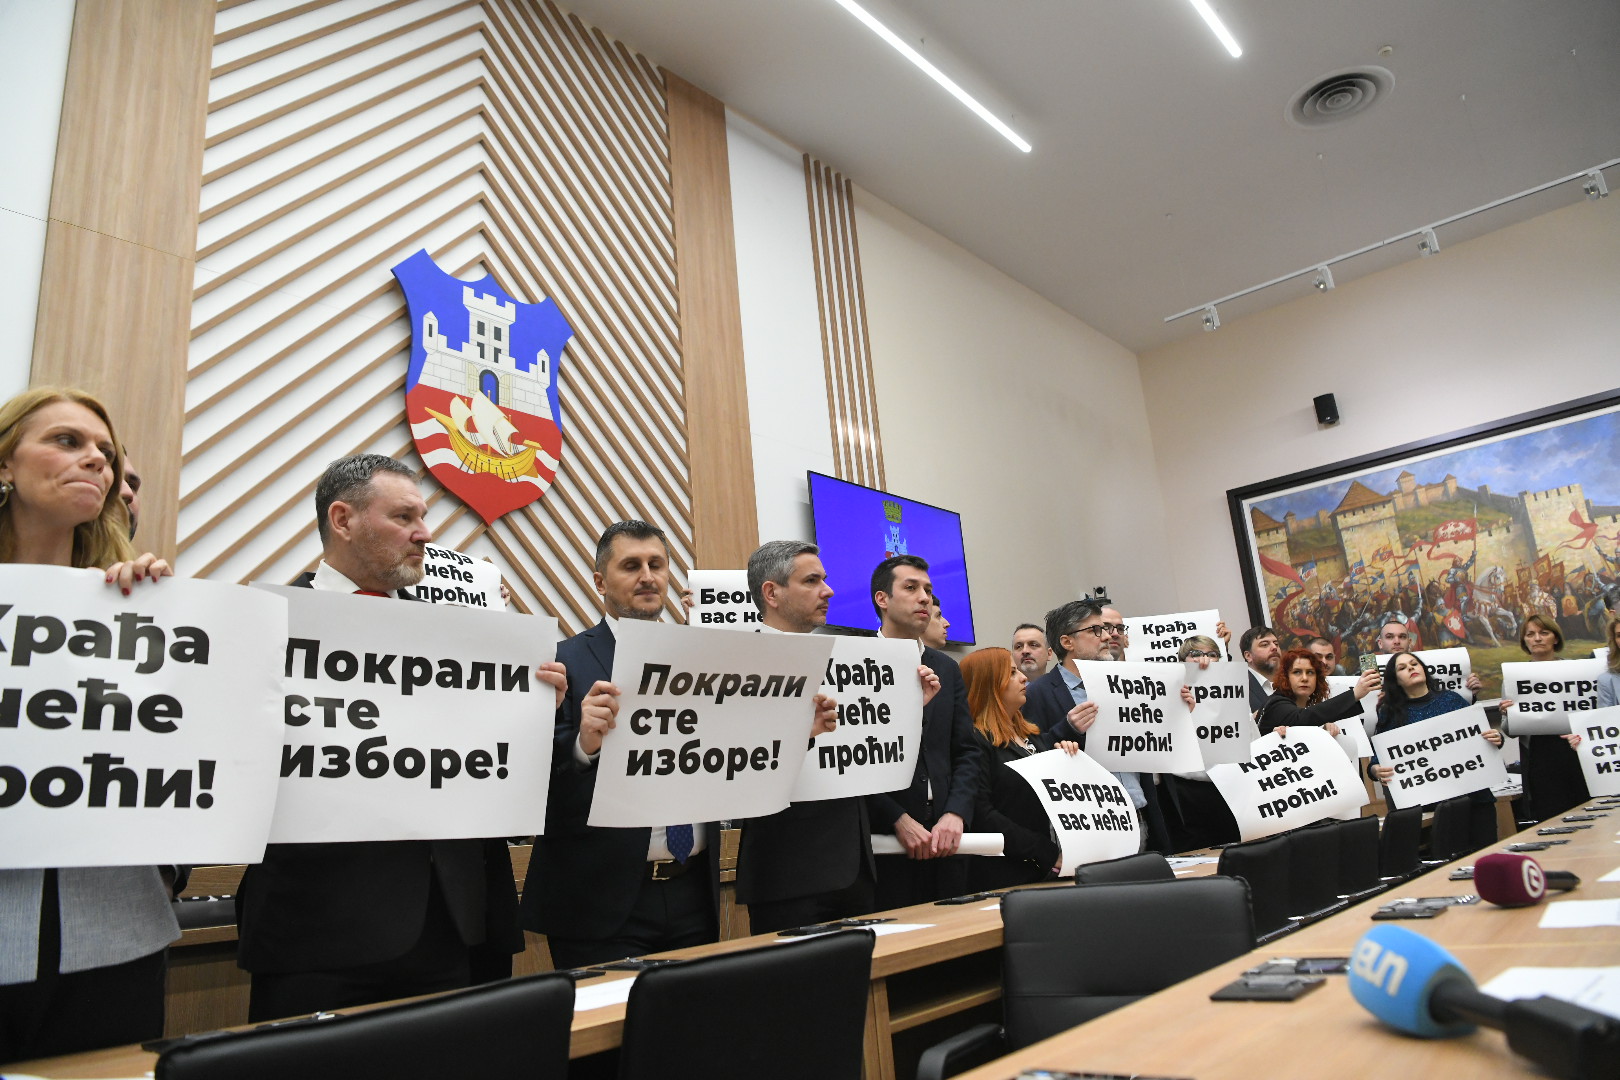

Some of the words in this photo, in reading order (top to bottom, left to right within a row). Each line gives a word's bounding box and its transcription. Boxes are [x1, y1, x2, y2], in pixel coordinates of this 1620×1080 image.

[425, 546, 474, 565] рађа
[424, 563, 474, 583] неће
[415, 585, 487, 607] проћи!
[700, 588, 753, 605] Беог
[700, 611, 737, 624] вас
[1142, 621, 1197, 636] Крађа
[1151, 636, 1183, 650] нећ
[284, 637, 530, 696] Покрали
[637, 662, 808, 704] Покрали
[1106, 675, 1166, 700] Крађа
[1189, 685, 1244, 703] рали
[1516, 680, 1598, 696] Беогр
[284, 694, 380, 730] сте
[1118, 703, 1163, 723] неће
[1518, 701, 1556, 712] вас
[630, 708, 698, 735] сте
[1196, 721, 1240, 743] оре!
[1107, 731, 1173, 756] проћи!
[1386, 723, 1481, 760] Покрали
[1591, 743, 1620, 757] ст
[279, 735, 510, 789] изборе!
[626, 738, 781, 780] изборе!
[818, 735, 905, 775] проћи!
[1394, 756, 1429, 774] сте
[0, 753, 216, 809] оћи!
[1257, 766, 1314, 791] неће
[1399, 754, 1485, 790] изборе!
[1041, 778, 1128, 808] Београд
[1257, 779, 1338, 818] проћи!
[1058, 813, 1090, 831] вас
[1091, 808, 1133, 832] неће!
